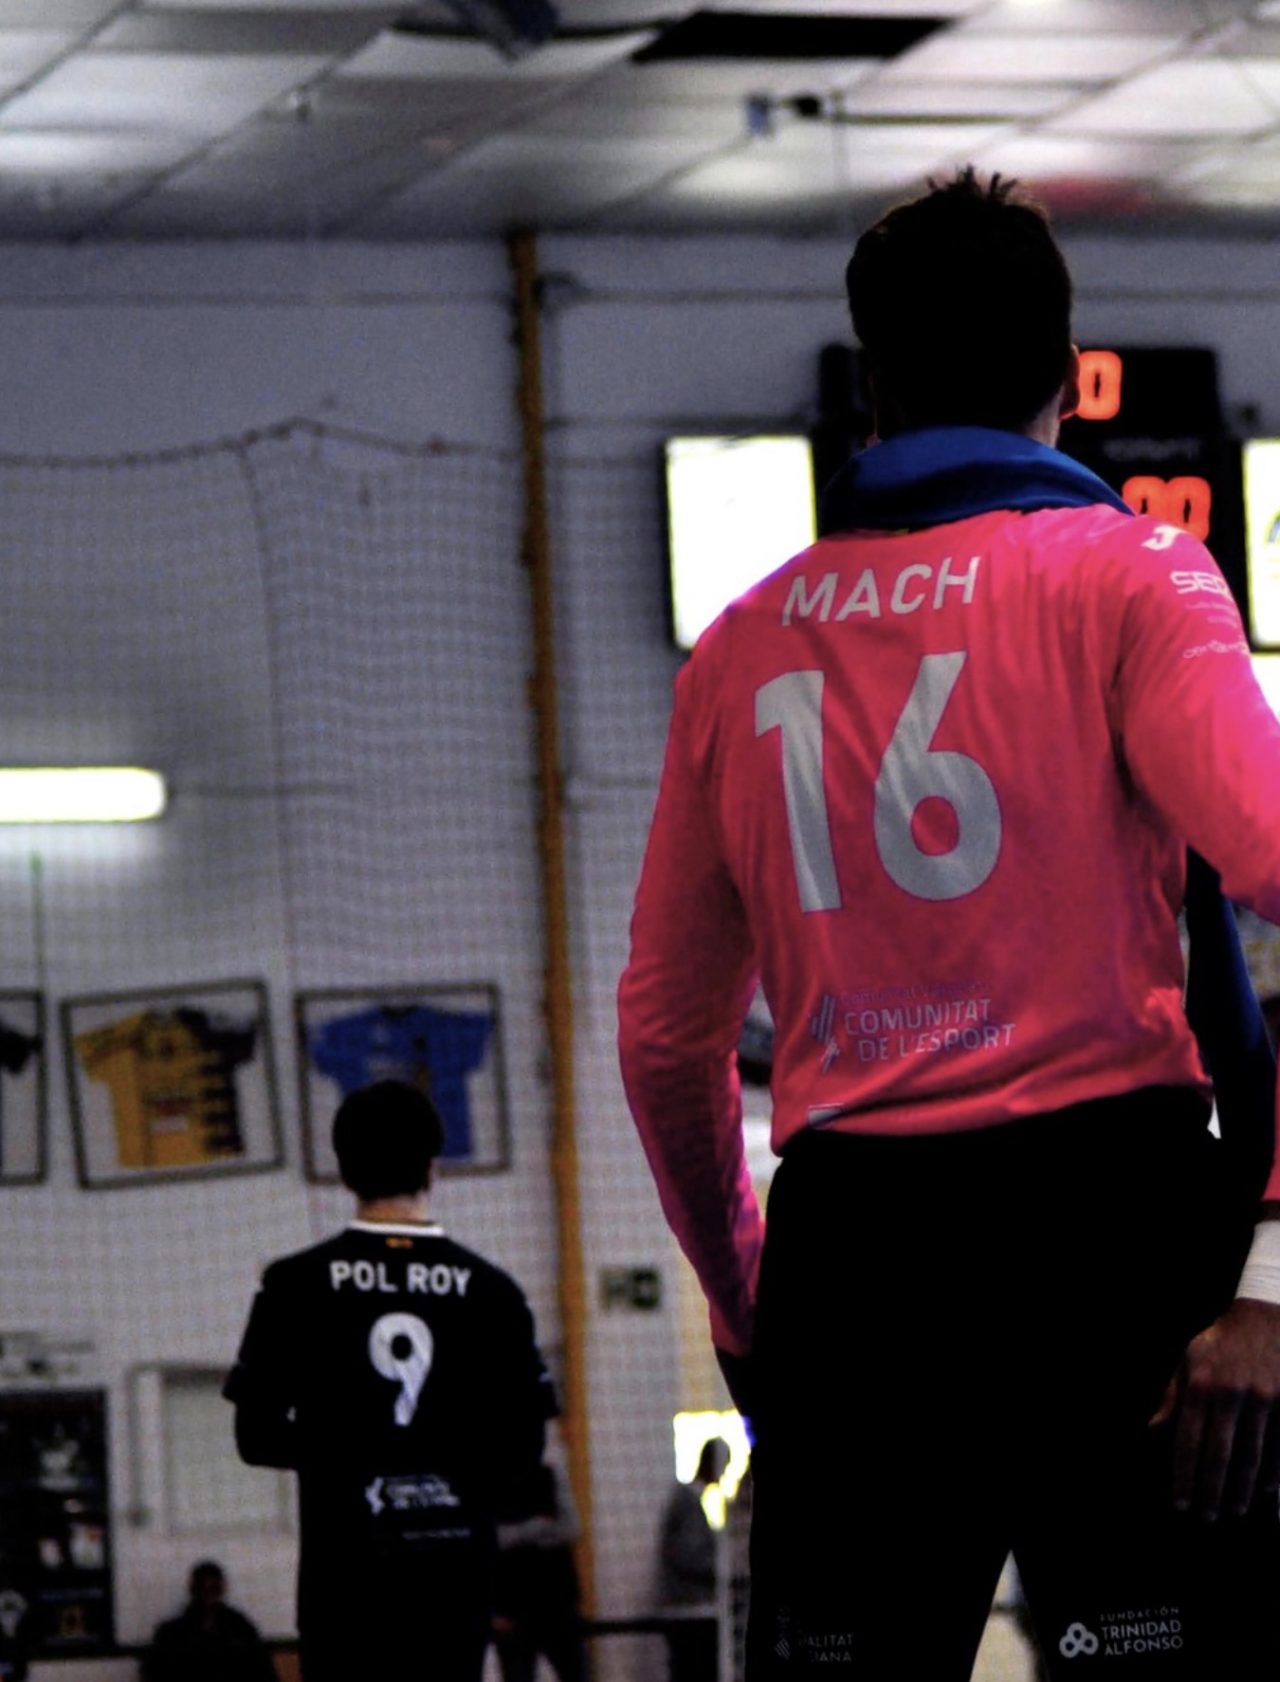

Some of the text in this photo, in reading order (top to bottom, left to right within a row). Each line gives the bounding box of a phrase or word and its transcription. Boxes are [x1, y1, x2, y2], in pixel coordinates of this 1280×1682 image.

[782, 557, 981, 626] MACH
[755, 651, 1000, 912] 16
[844, 998, 992, 1036] COMUNITAT
[857, 1037, 890, 1062] DE
[330, 1261, 471, 1297] POL ROY
[368, 1311, 434, 1426] 9
[1099, 1605, 1180, 1623] FUNDACIÓN
[1101, 1618, 1183, 1640] TRINIDAD
[1104, 1634, 1184, 1657] ALFONSO
